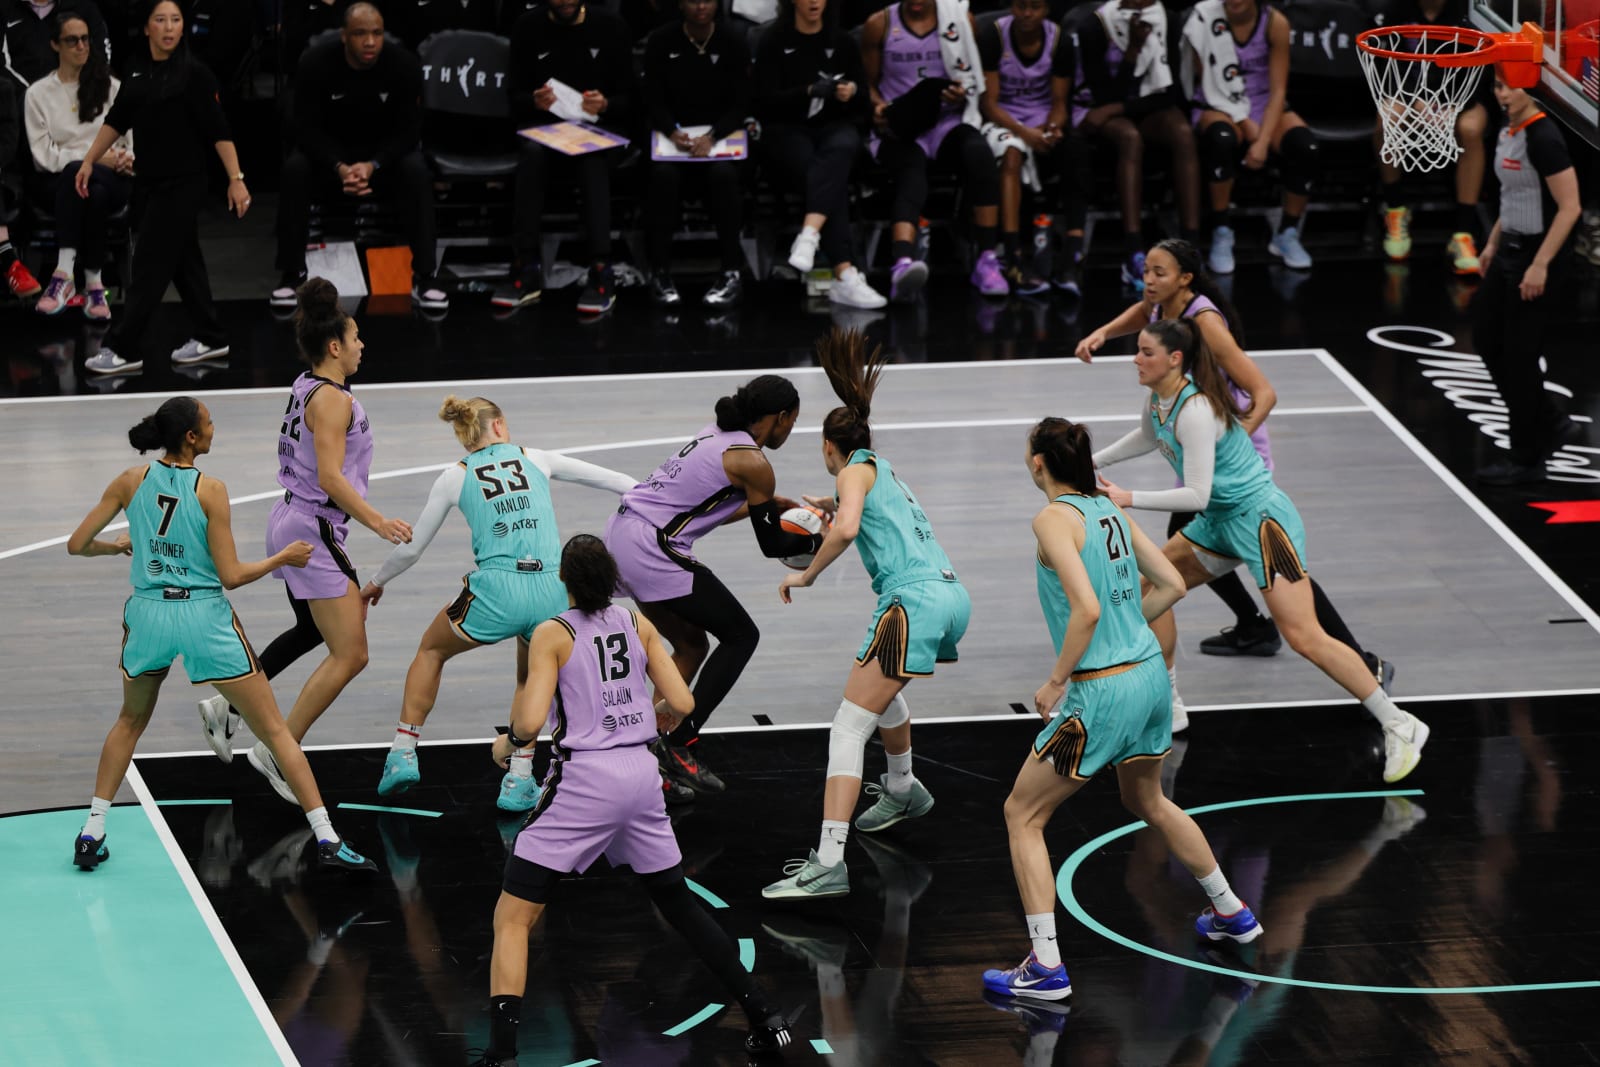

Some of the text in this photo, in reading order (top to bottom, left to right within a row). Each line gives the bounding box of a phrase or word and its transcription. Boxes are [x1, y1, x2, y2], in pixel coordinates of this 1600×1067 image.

[278, 440, 295, 458] URTO
[679, 434, 715, 458] 6
[474, 459, 531, 501] 53
[157, 493, 181, 537] 7
[493, 495, 531, 515] VANLOO
[511, 518, 539, 532] AT&T
[1099, 514, 1130, 562] 21
[1116, 563, 1129, 580] HAN
[593, 632, 631, 683] 13
[602, 686, 633, 708] SALAÜN
[618, 711, 644, 727] AT&T
